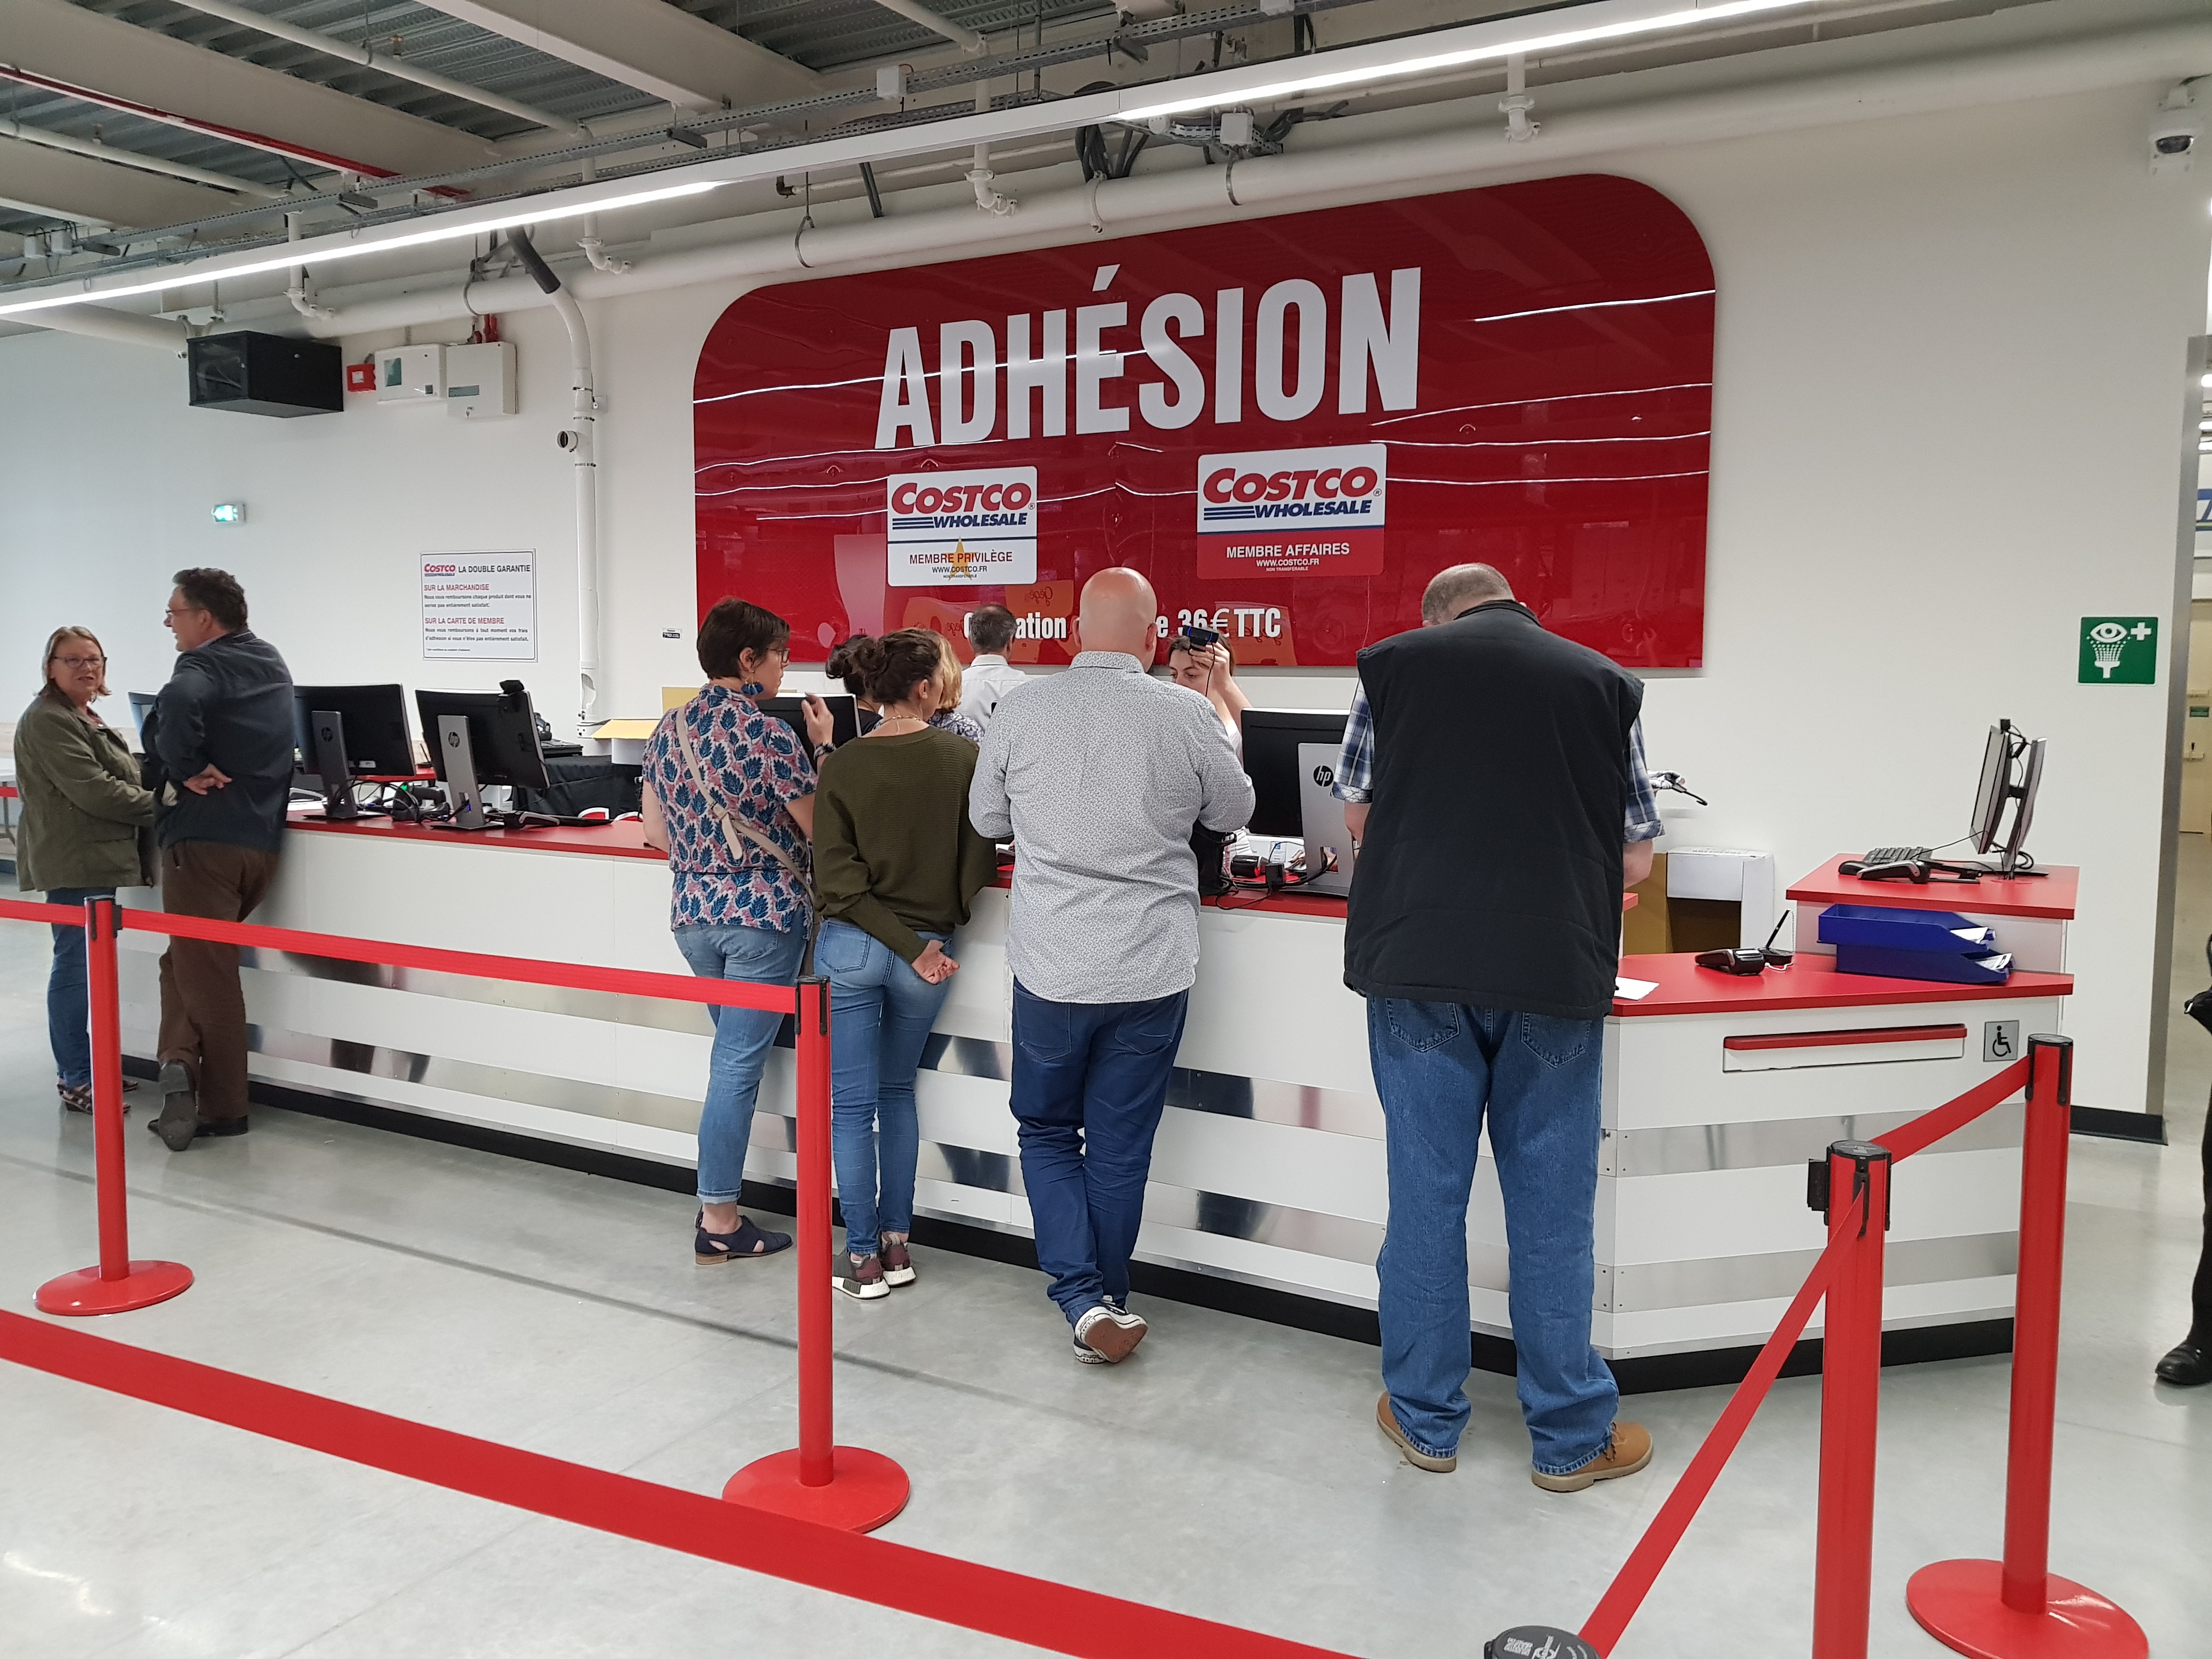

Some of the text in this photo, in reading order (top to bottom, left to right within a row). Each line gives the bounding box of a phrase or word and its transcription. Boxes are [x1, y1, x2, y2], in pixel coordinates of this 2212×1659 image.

[874, 264, 1421, 450] ADHÉSION
[1254, 500, 1372, 519] WHOLESALE
[933, 512, 1028, 528] WHOLESALE
[909, 549, 1013, 564] MEMBRE PRIVILÈGE
[1226, 542, 1350, 558] MEMBRE AFFAIRES
[1256, 558, 1319, 567] WWW.COSTCO.FR
[1315, 766, 1333, 787] hp
